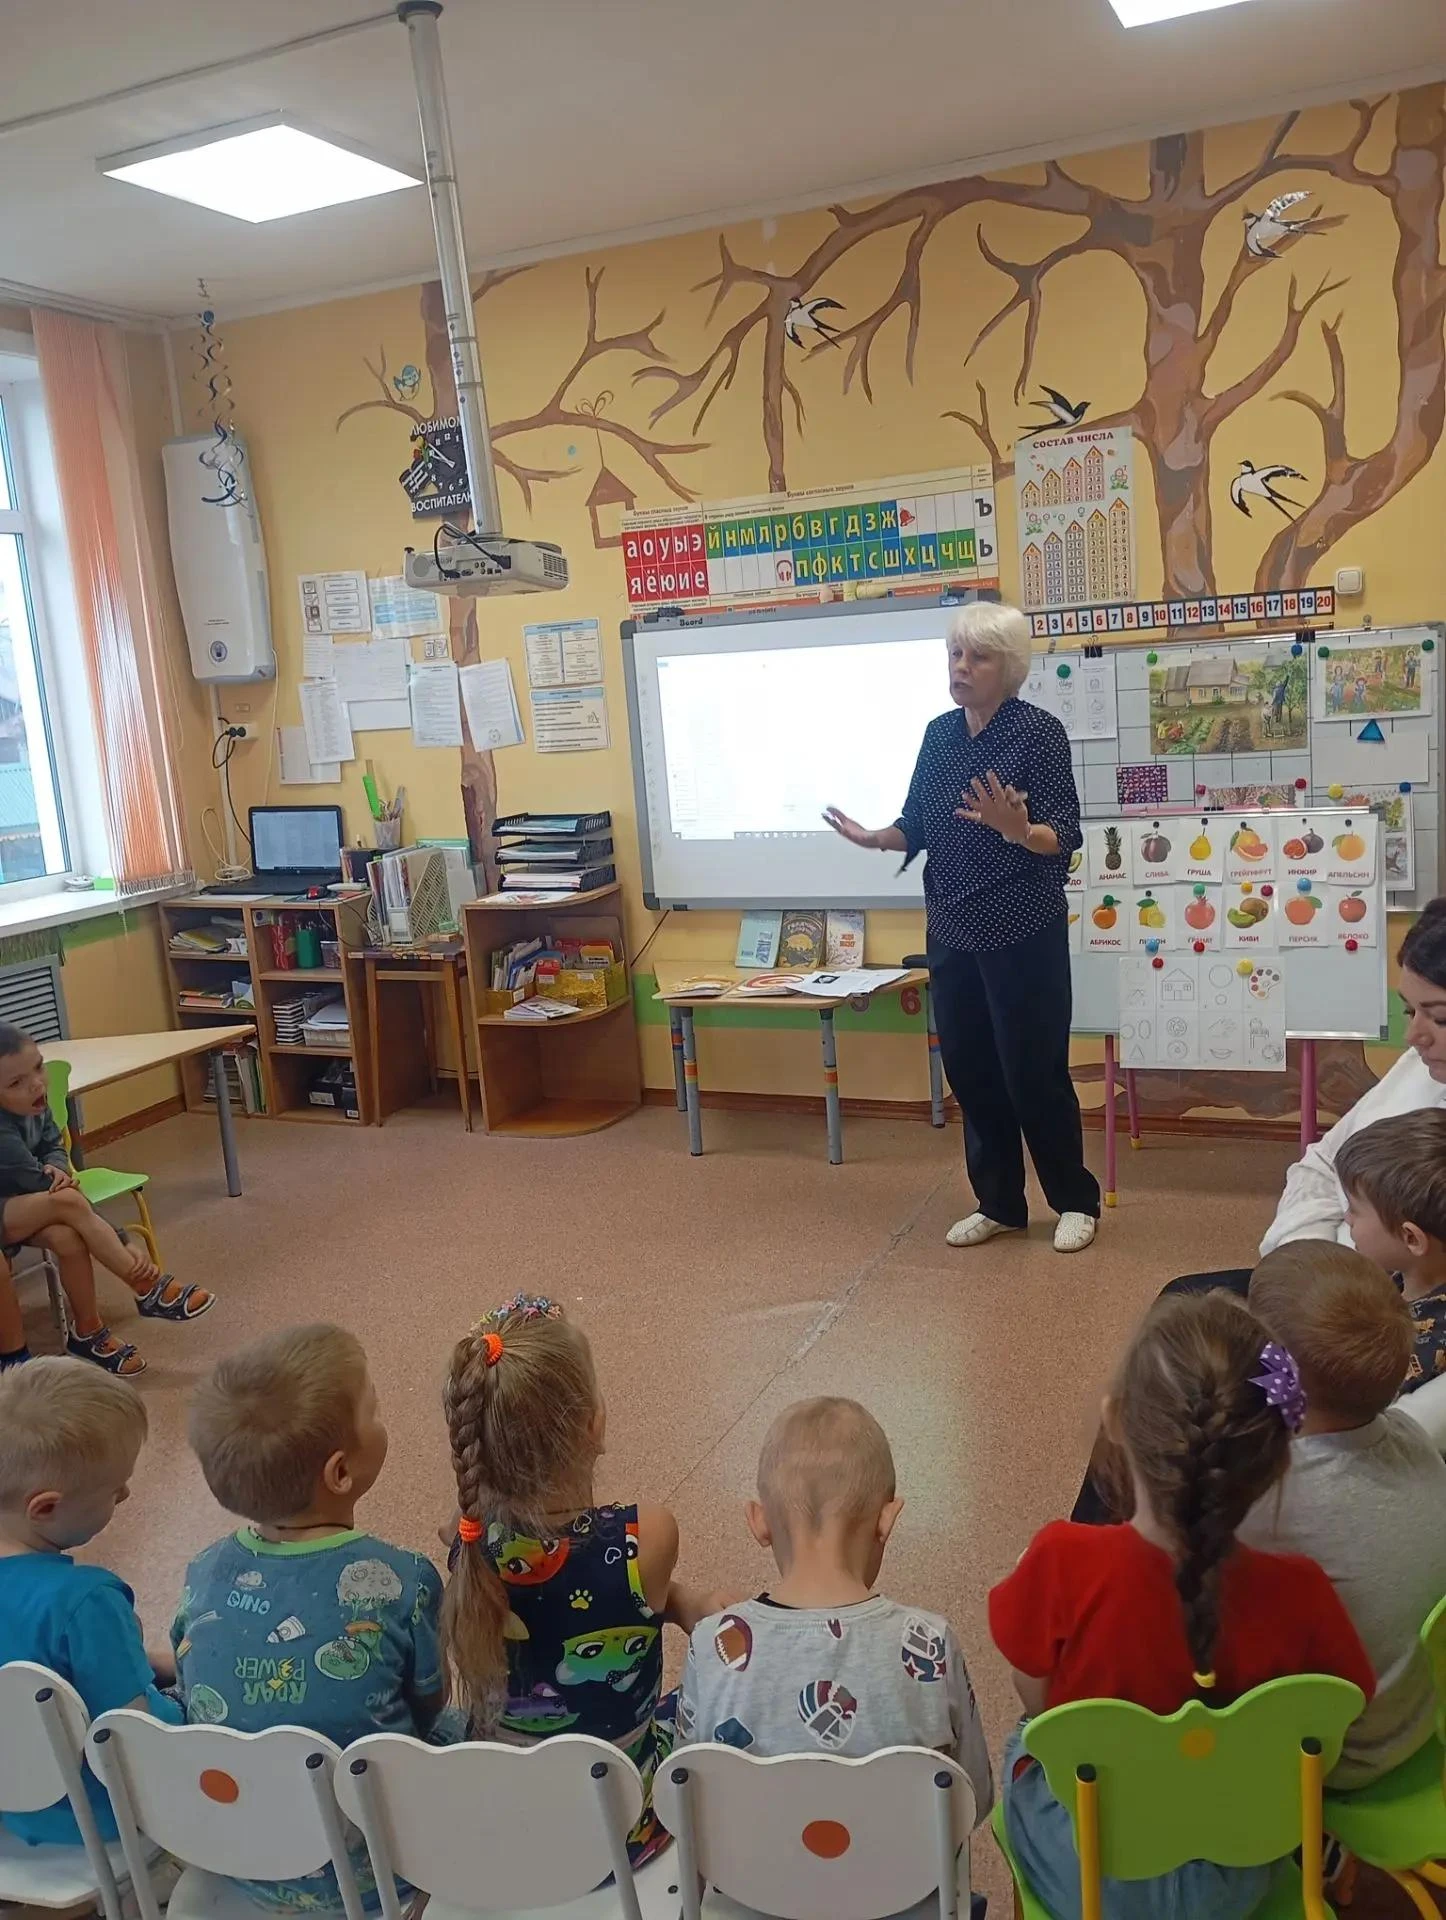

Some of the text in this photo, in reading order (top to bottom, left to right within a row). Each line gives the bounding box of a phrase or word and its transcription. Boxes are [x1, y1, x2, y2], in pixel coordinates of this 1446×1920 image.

[1033, 431, 1114, 449] СОСТАВ ЧИСЛА
[431, 474, 437, 482] 8
[458, 478, 464, 486] 5
[708, 510, 897, 549] й н м л р б в г д з ж
[626, 533, 701, 561] а о у ы э
[796, 540, 975, 582] п ф к т с ш х ц ч щ
[631, 569, 705, 595] я ё ю и е
[1036, 595, 1331, 631] 2 3 4 5 6 7 8 9 10 11 12 13 14 15 16 17 18 19 20
[1098, 872, 1127, 880] АНАНАС
[901, 986, 921, 1015] 6
[227, 1590, 271, 1615] DINO
[234, 1656, 306, 1681] POWER
